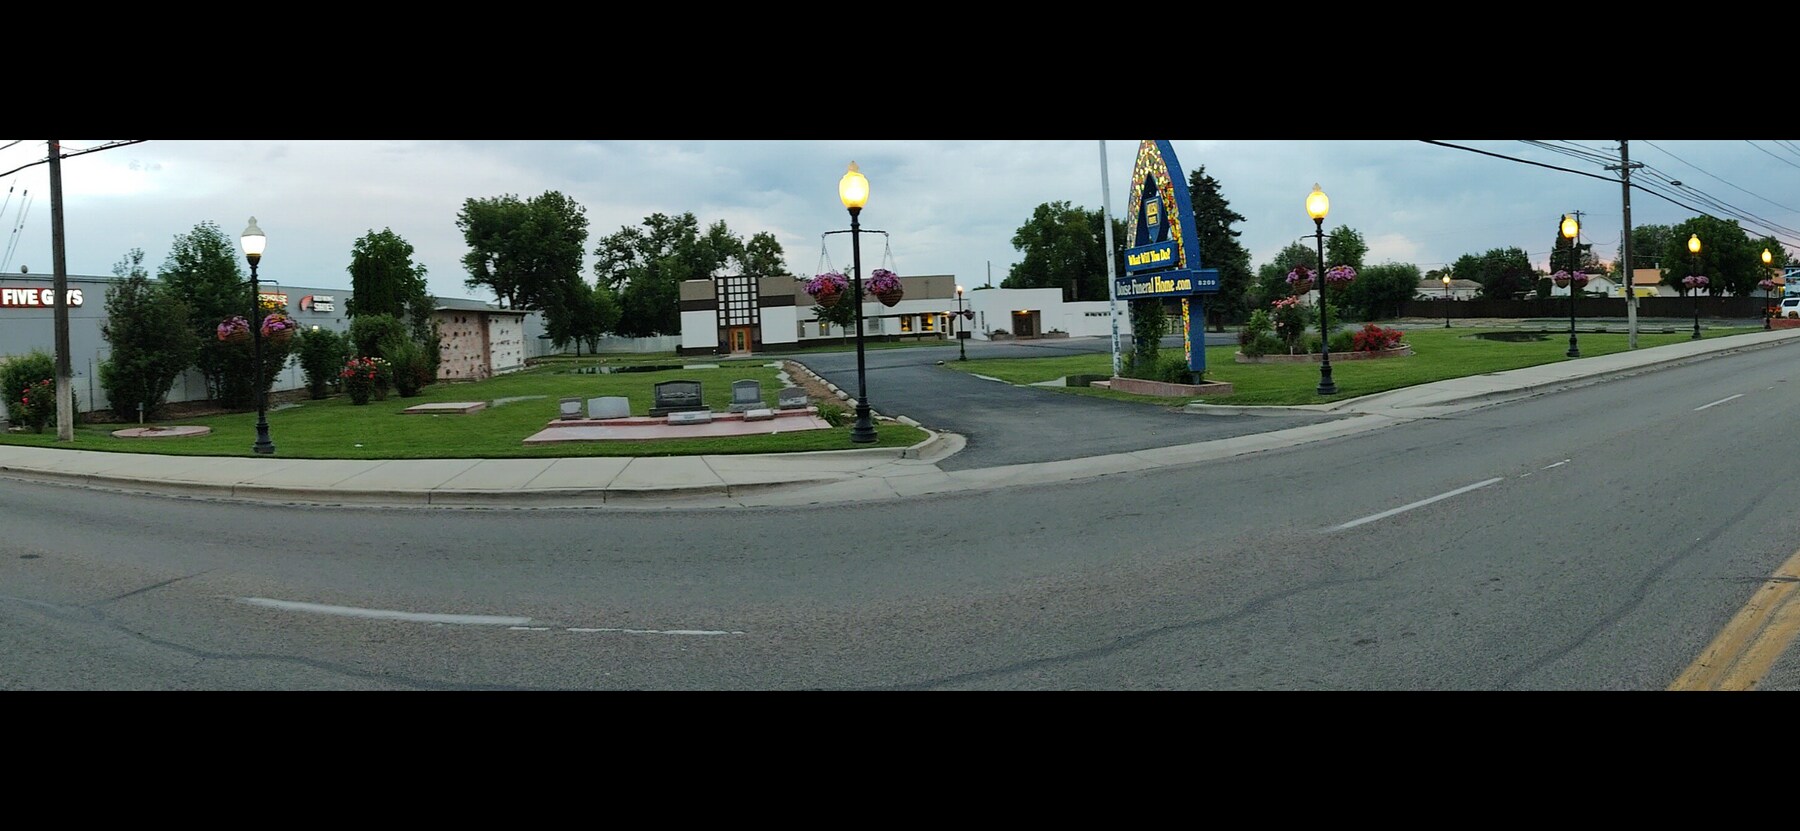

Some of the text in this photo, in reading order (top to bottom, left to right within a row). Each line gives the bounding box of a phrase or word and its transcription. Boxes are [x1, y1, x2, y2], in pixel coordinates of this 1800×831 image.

[1128, 254, 1141, 266] What
[1150, 250, 1160, 262] You
[1131, 277, 1154, 295] Funeral
[1154, 276, 1175, 293] Home
[2, 289, 84, 305] FIVE GYS
